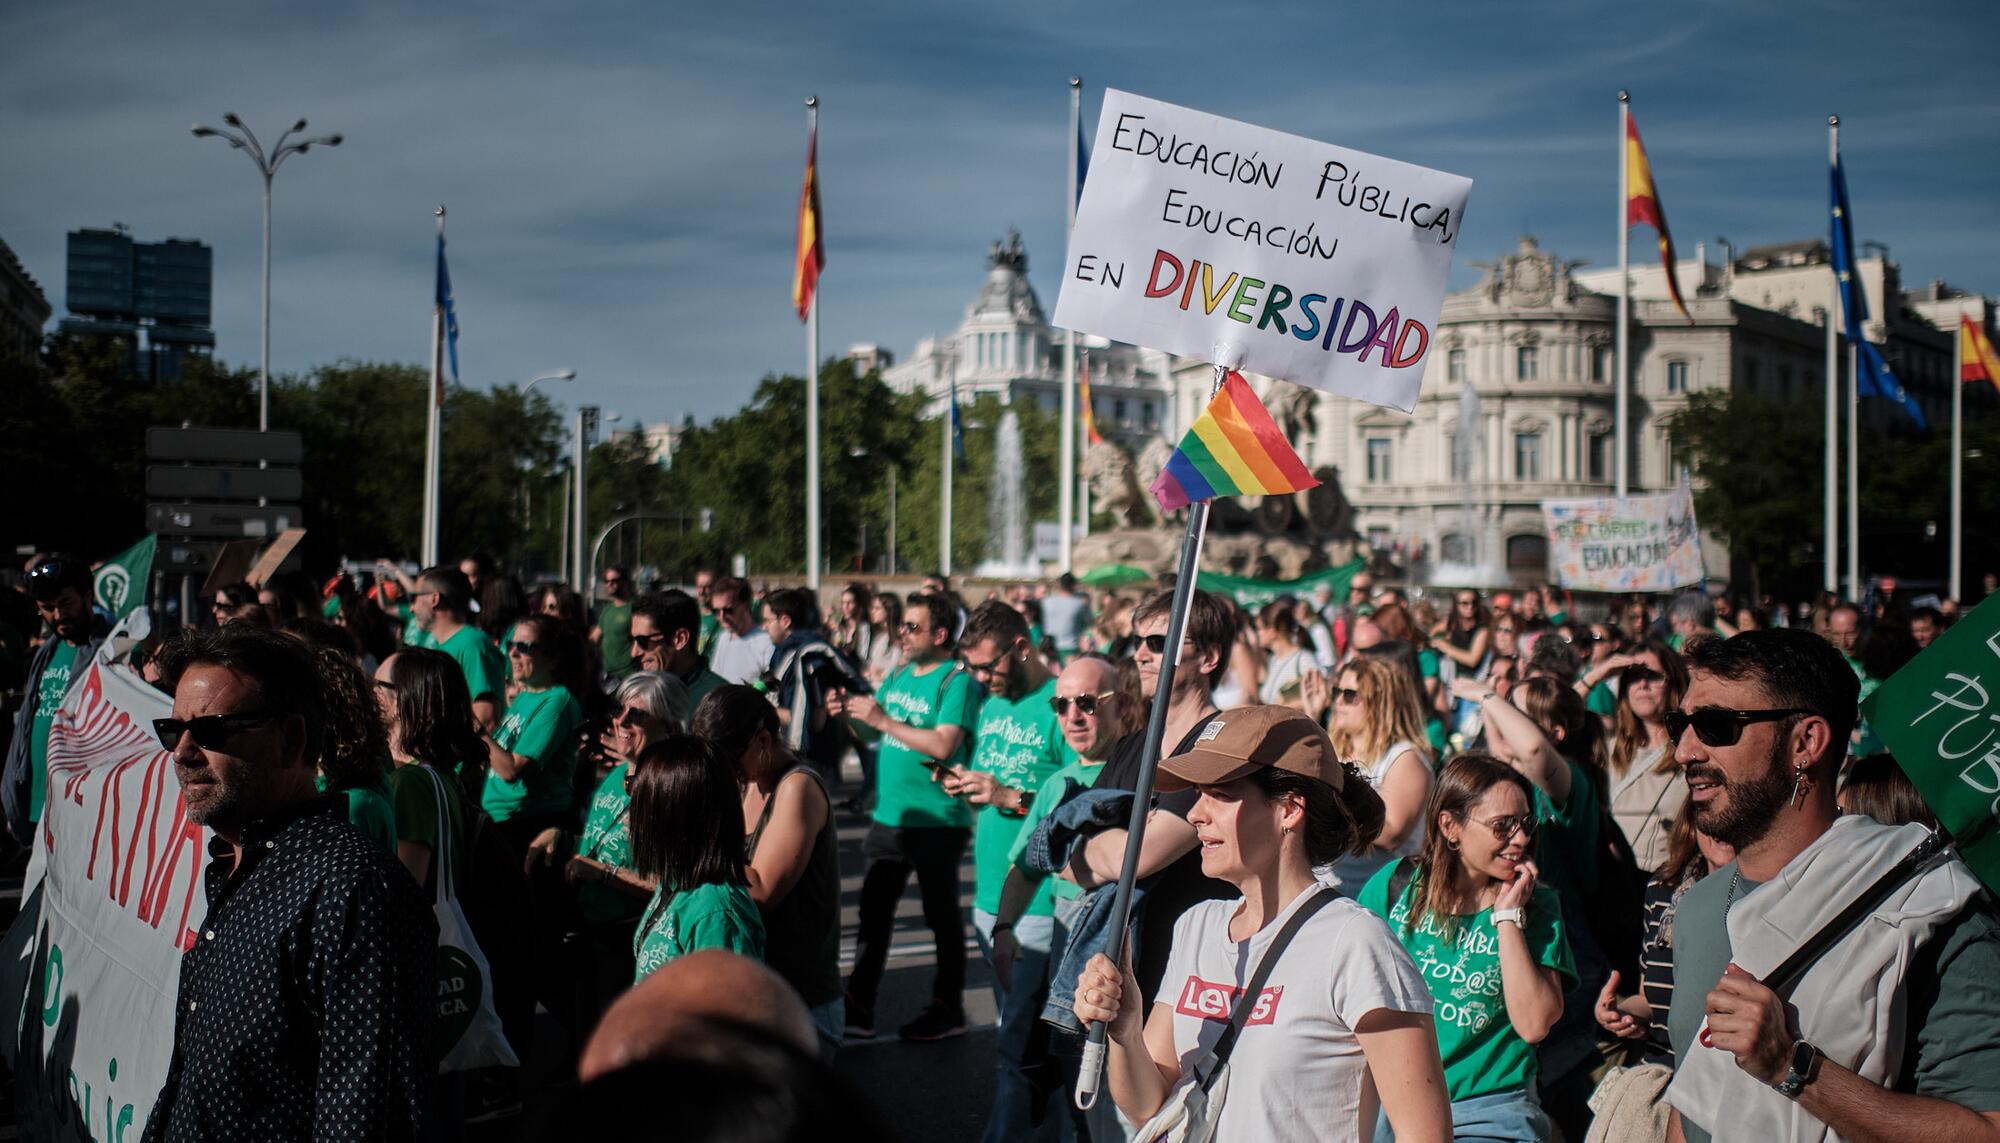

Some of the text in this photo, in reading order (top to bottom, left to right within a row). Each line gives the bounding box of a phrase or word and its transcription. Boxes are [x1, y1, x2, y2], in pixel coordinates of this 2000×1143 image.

[1112, 113, 1283, 189] EDUCACIÓN
[1163, 189, 1338, 259] EDUCACIÓN
[1076, 248, 1429, 369] EN DIVERSIDAD
